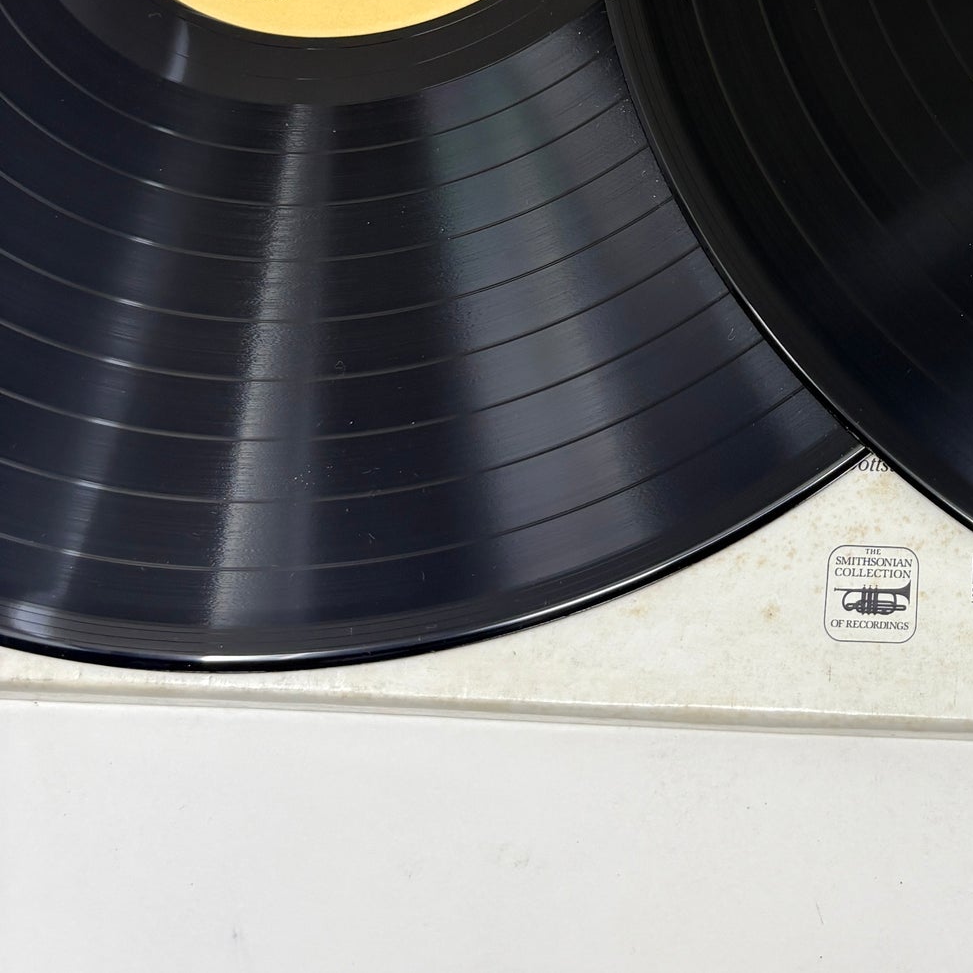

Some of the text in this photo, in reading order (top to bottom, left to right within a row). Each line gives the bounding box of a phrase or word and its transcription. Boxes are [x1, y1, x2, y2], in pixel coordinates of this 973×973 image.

[835, 556, 913, 568] SMITHSONIAN
[834, 567, 912, 579] COLLECTION
[830, 619, 909, 630] OF RECORDINGS
